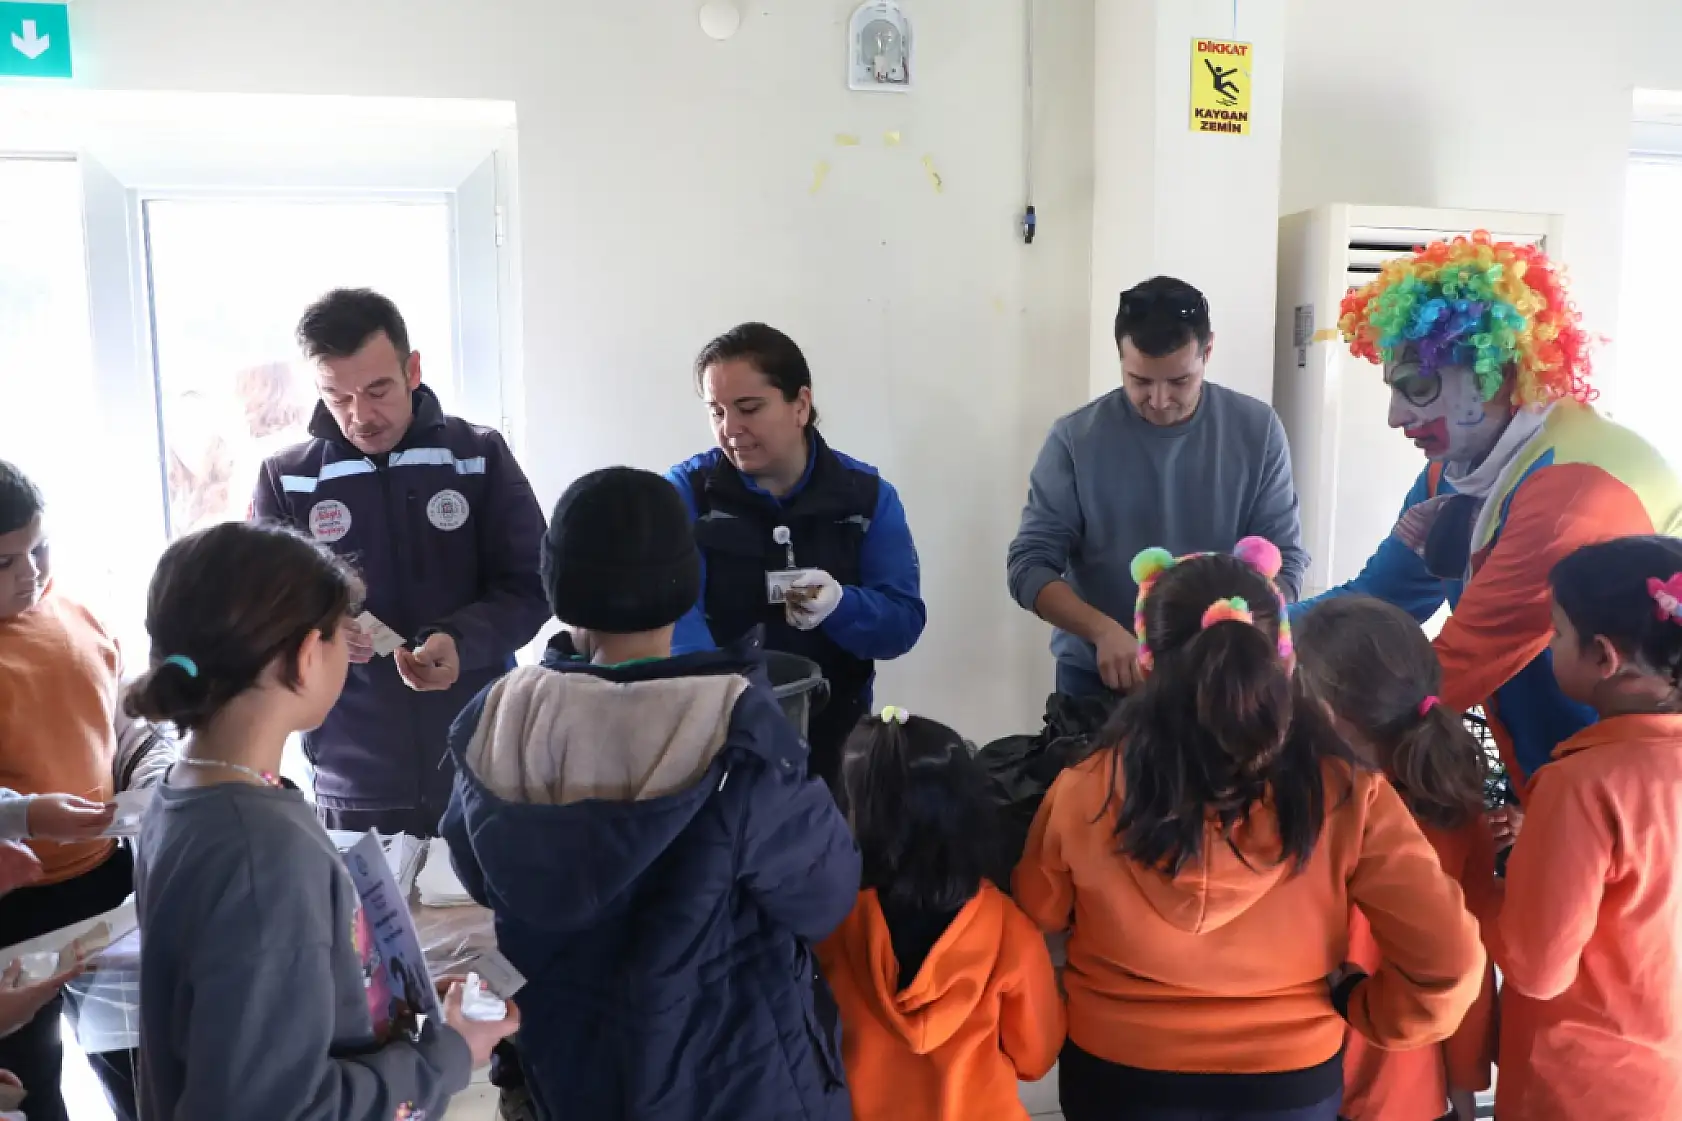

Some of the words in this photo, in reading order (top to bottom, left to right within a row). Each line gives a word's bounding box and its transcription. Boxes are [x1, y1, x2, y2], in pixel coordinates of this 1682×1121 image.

[1197, 41, 1248, 56] DİKKAT
[1195, 107, 1248, 121] KAYGAN
[1200, 120, 1241, 133] ZEMİN
